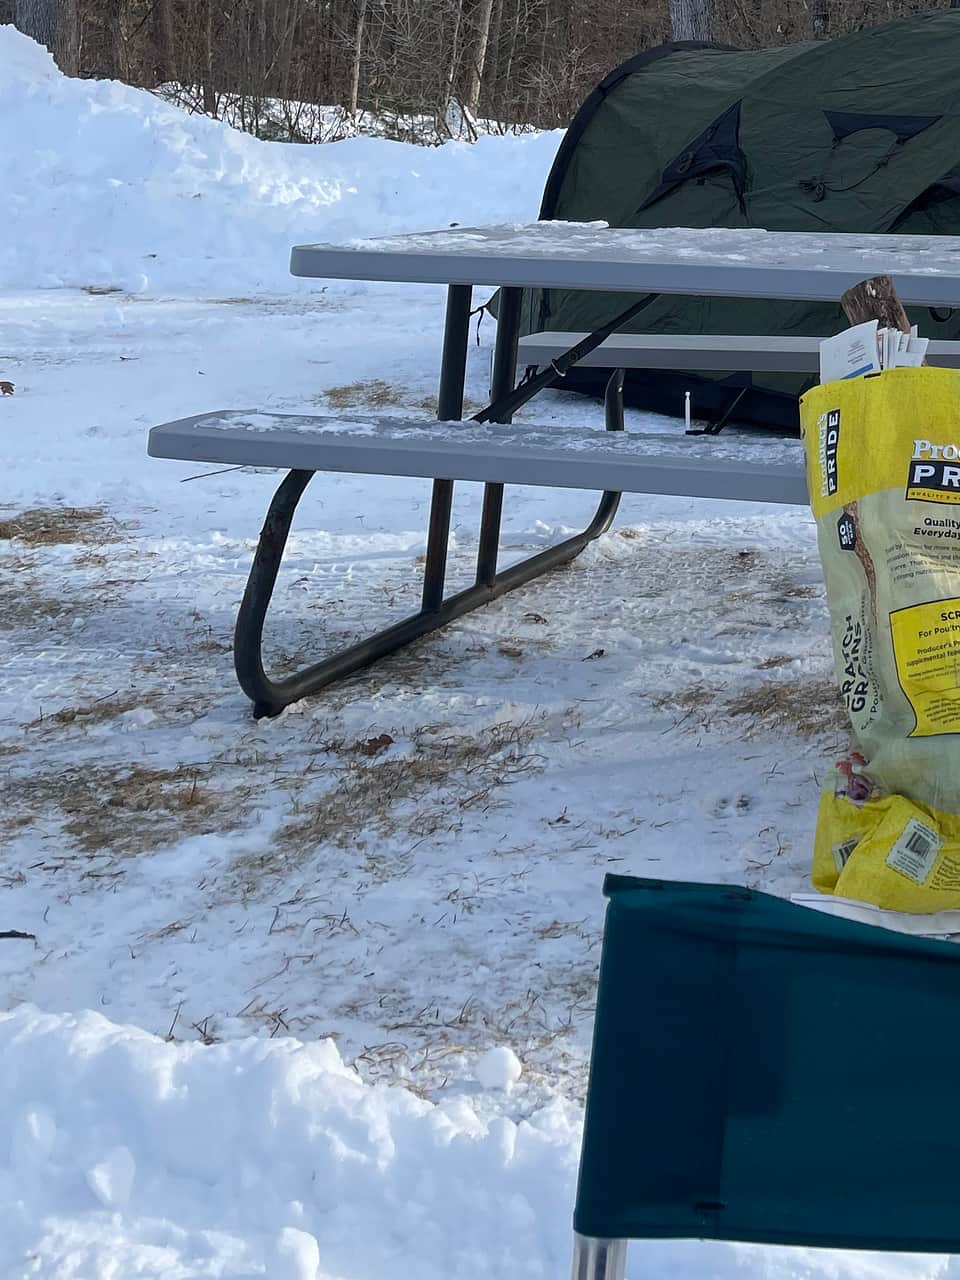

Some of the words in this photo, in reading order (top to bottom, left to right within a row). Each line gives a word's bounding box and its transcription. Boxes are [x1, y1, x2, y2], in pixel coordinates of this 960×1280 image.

[827, 412, 839, 492] PRIDE
[839, 524, 848, 545] 50
[918, 630, 932, 639] For
[841, 614, 856, 707] RATCH
